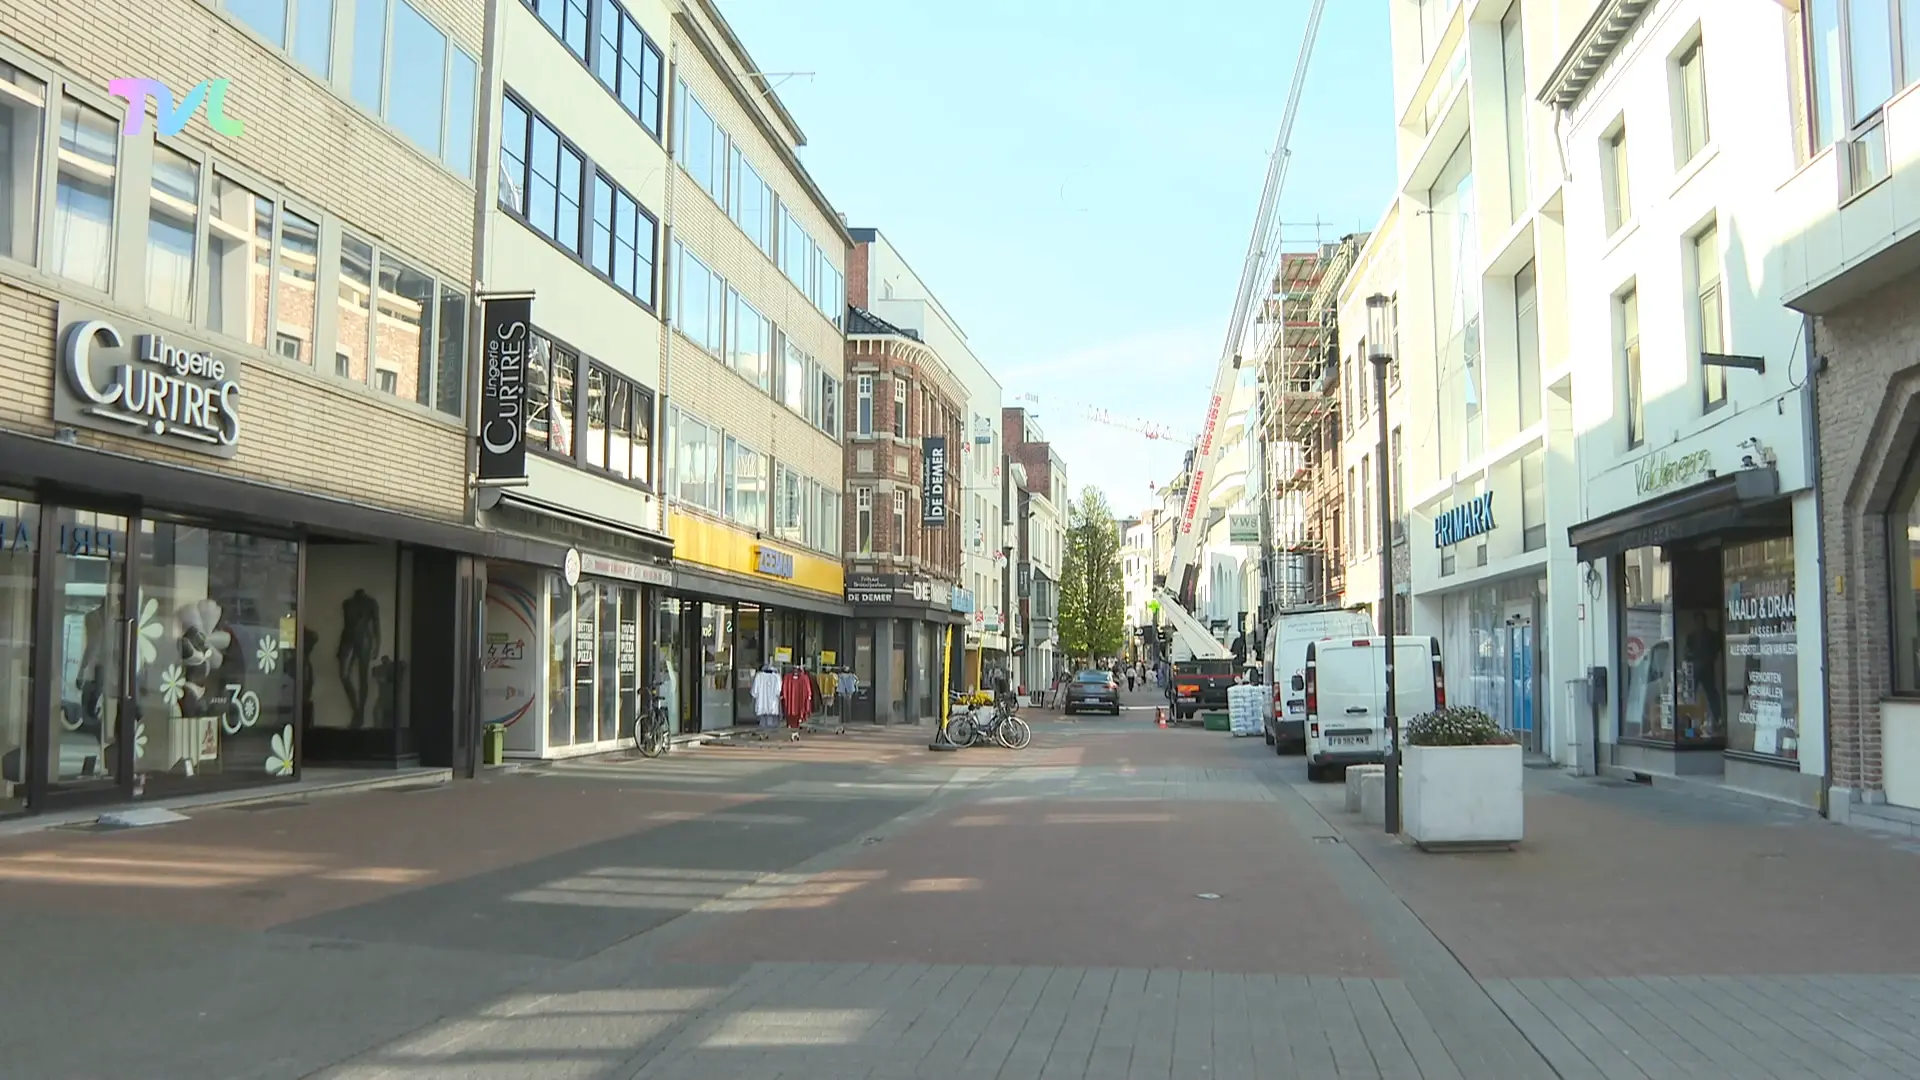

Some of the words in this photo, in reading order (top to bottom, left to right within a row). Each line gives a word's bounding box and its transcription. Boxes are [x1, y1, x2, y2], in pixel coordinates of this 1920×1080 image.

[148, 333, 226, 381] Lingerie
[486, 340, 501, 397] Lingerie
[68, 319, 241, 446] CURTRES
[483, 321, 526, 454] CURTRES
[931, 447, 945, 495] DEMER
[931, 498, 944, 517] DE
[1434, 490, 1496, 549] PRIMARK
[755, 545, 794, 579] ZEEMAN
[847, 593, 860, 602] DE
[861, 593, 892, 602] DEMER
[1728, 598, 1758, 622] NAALD
[1759, 596, 1766, 619] &
